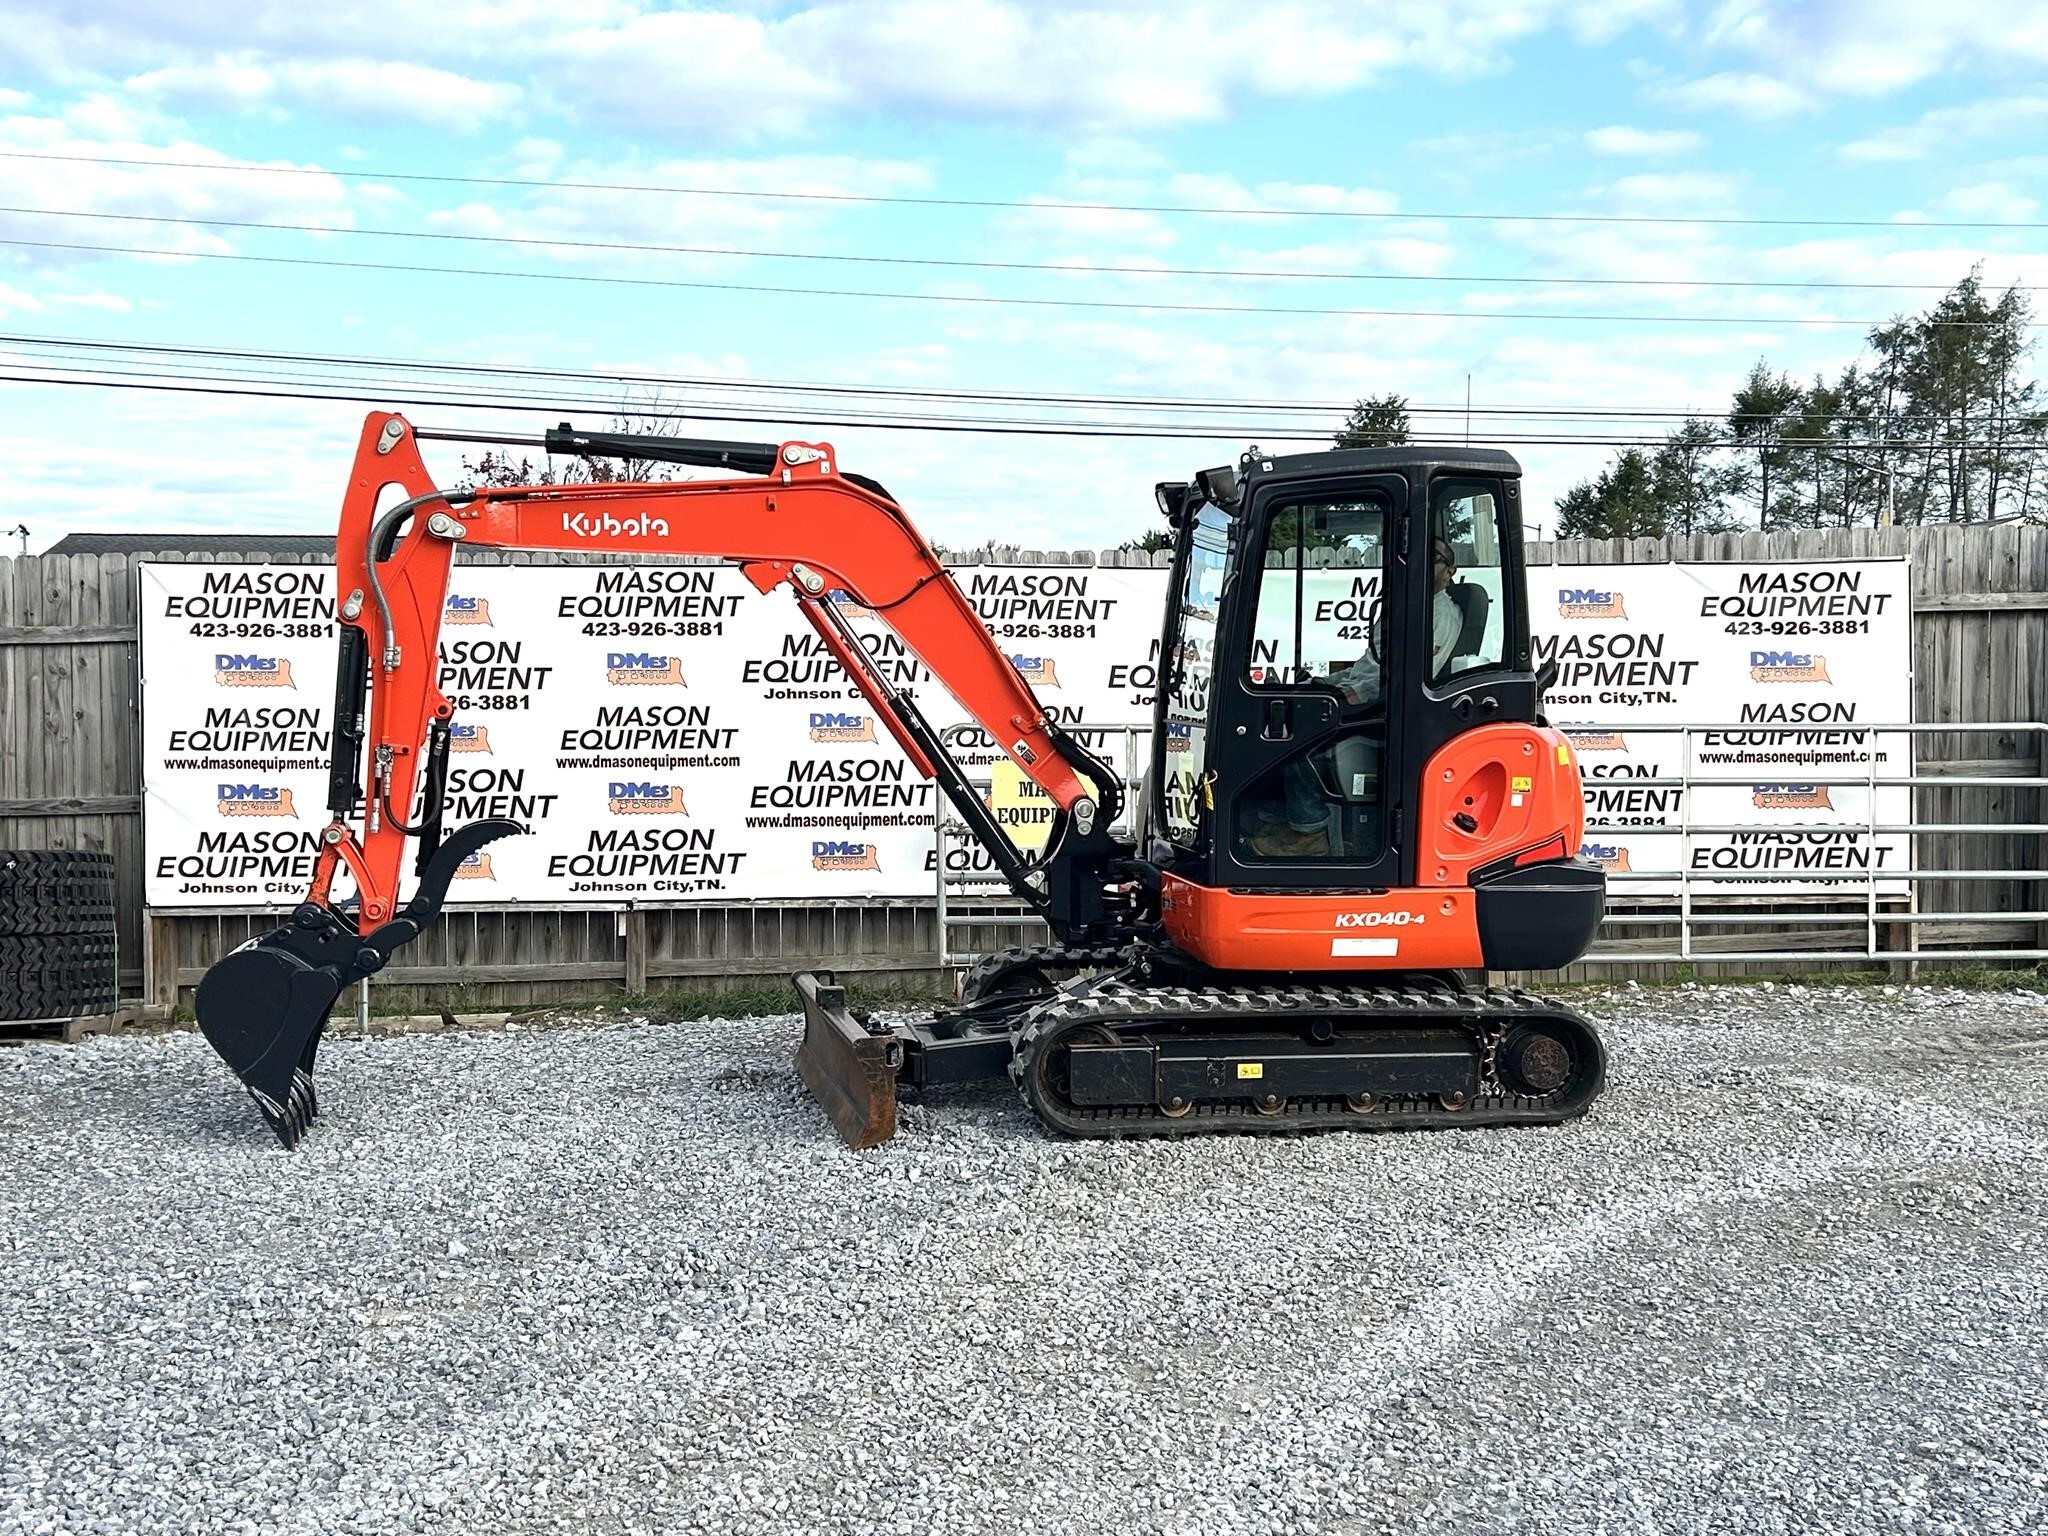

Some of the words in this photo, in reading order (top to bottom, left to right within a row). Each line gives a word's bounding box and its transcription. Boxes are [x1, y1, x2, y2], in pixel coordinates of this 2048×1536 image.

[562, 512, 669, 537] Kubota
[202, 572, 325, 595] MASON
[595, 571, 715, 594] MASON
[970, 574, 1088, 597] MASON
[1738, 571, 1862, 594] MASON
[164, 596, 335, 619] EQUIPMEN
[558, 595, 745, 618] EQUIPMENT
[969, 599, 1117, 621] UIPMENT
[1700, 593, 1892, 618] EQUIPMENT
[189, 622, 333, 638] 423-926-3881
[581, 621, 723, 637] 423-926-3881
[987, 624, 1097, 639] 3-926-3881
[1724, 619, 1869, 636] 423-926-3881
[440, 641, 521, 664] SON
[782, 635, 905, 657] MAON
[1532, 634, 1664, 659] MASON
[742, 661, 930, 683] EQUIPEN
[1555, 660, 1699, 687] IPMENT
[451, 695, 530, 710] 26-3881
[764, 688, 842, 699] Johnson
[1544, 693, 1592, 705] nson
[1598, 691, 1677, 707] City,TN.
[204, 707, 321, 729] MASON
[596, 705, 711, 727] MASON
[1740, 702, 1857, 723] MASON
[168, 730, 330, 752] EQUIPMEN
[560, 728, 739, 751] EQUIPMENT
[1704, 731, 1865, 746] EQUIPMEN
[163, 755, 331, 773] www.dmasonequipment.c
[555, 753, 741, 771] www.dmasonequipment.com
[1699, 750, 1887, 765] www.dmasonequipment.cm
[446, 769, 524, 792] SON
[786, 759, 905, 783] MASON
[750, 783, 935, 809] EQUIPMENT
[1584, 790, 1683, 812] PMENT
[745, 811, 937, 831] www.dmasonequipment.com
[997, 808, 1056, 827] EQUIP
[196, 830, 325, 854] MASON
[587, 828, 715, 852] MASON
[157, 856, 349, 878] EQUIPME
[547, 852, 747, 878] EQUIPMENT
[1691, 847, 1893, 869] EQUIPMENT
[178, 882, 258, 894] Johnson
[568, 881, 647, 892] Johnson
[653, 878, 726, 894] City,TN.
[1335, 912, 1425, 927] KX040-4
